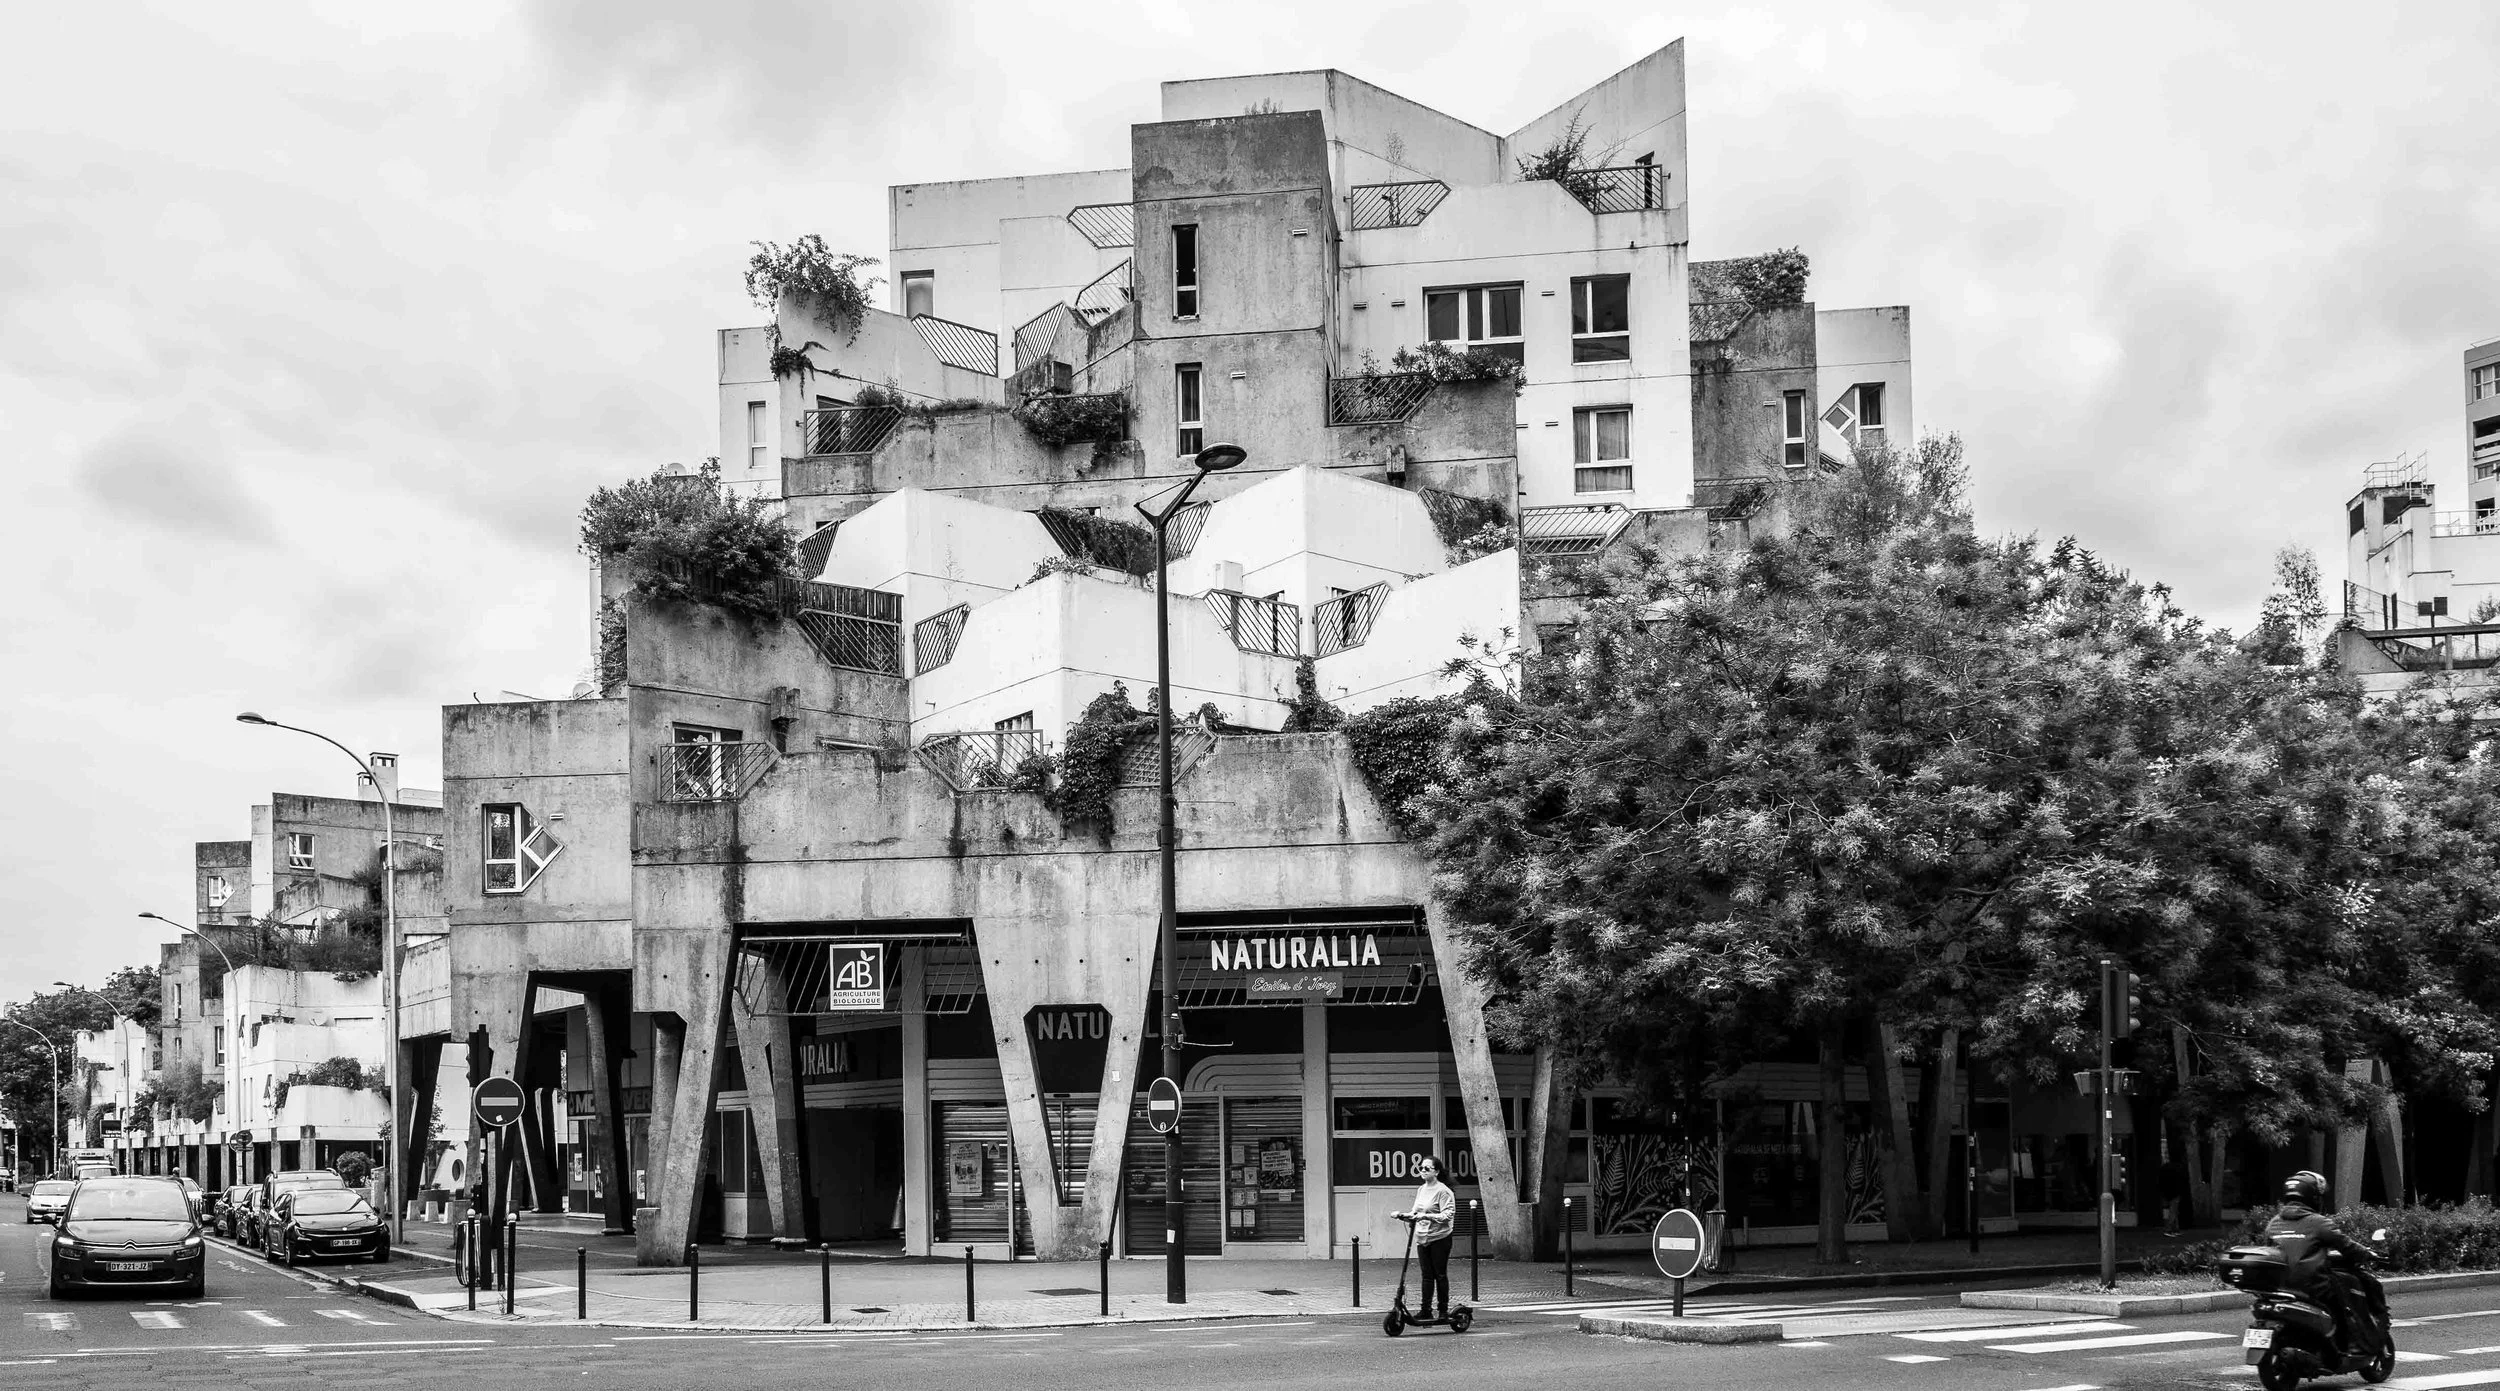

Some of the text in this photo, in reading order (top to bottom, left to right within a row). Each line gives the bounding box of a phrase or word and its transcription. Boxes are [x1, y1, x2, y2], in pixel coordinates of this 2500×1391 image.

[1211, 934, 1381, 971] NATURALIA
[836, 960, 873, 989] AB
[1369, 1150, 1406, 1178] BIO
[1410, 1152, 1422, 1178] &
